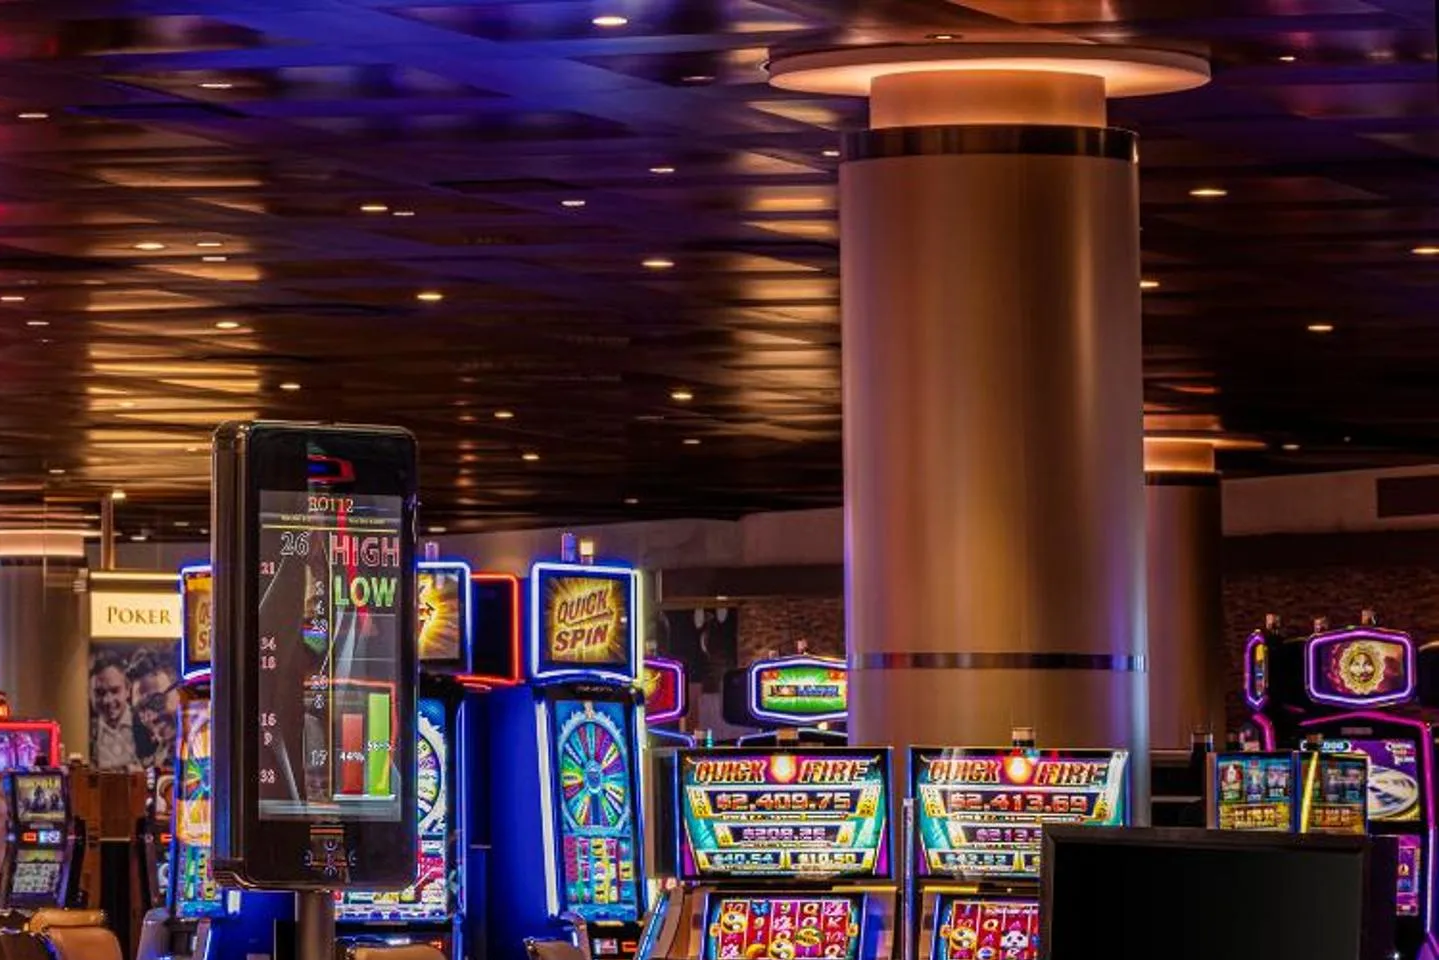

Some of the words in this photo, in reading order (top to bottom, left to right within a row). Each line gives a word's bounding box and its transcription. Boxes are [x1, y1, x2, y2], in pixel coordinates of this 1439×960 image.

[280, 531, 310, 556] 26
[330, 535, 400, 567] HIGH
[334, 576, 398, 607] LOW
[108, 606, 171, 625] POKER
[558, 590, 607, 623] QUICK
[555, 625, 608, 652] SPIN
[695, 760, 768, 784] QUICK
[798, 760, 872, 784] FIRE
[928, 760, 1002, 784] QUICK
[1034, 761, 1107, 786] FIRE
